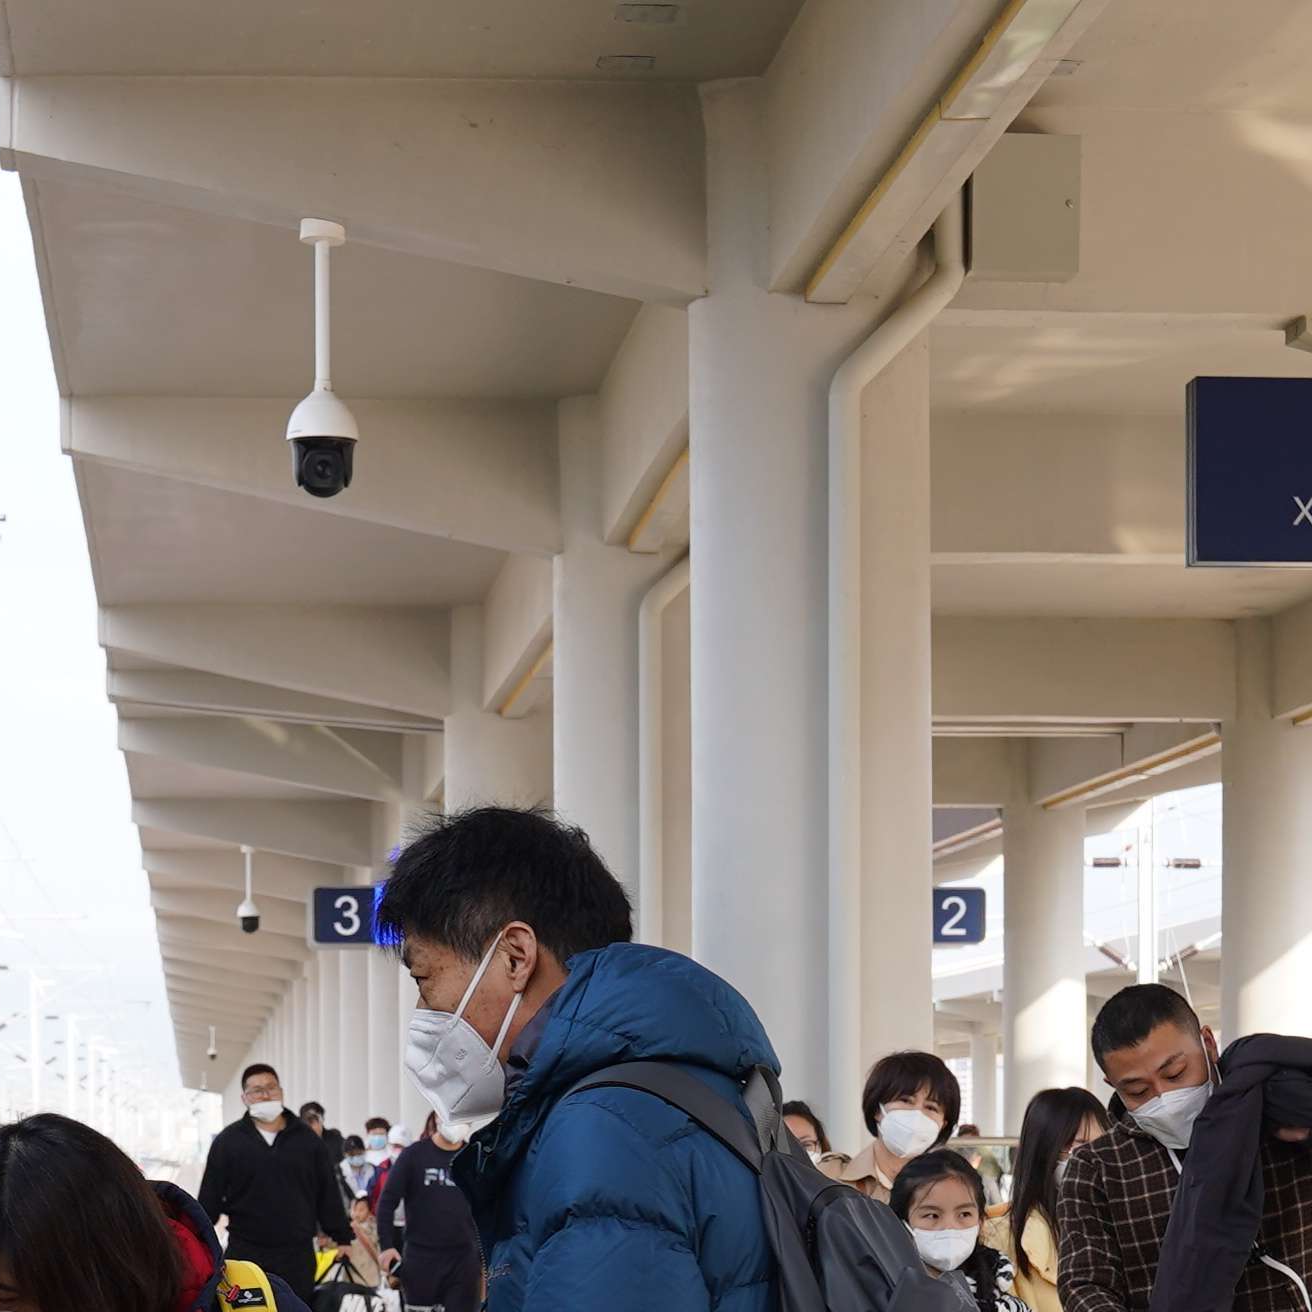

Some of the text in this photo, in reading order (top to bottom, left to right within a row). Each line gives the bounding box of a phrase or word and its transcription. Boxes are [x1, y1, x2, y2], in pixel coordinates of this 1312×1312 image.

[333, 895, 361, 936] 3
[940, 896, 967, 936] 2
[424, 1168, 456, 1186] FIL
